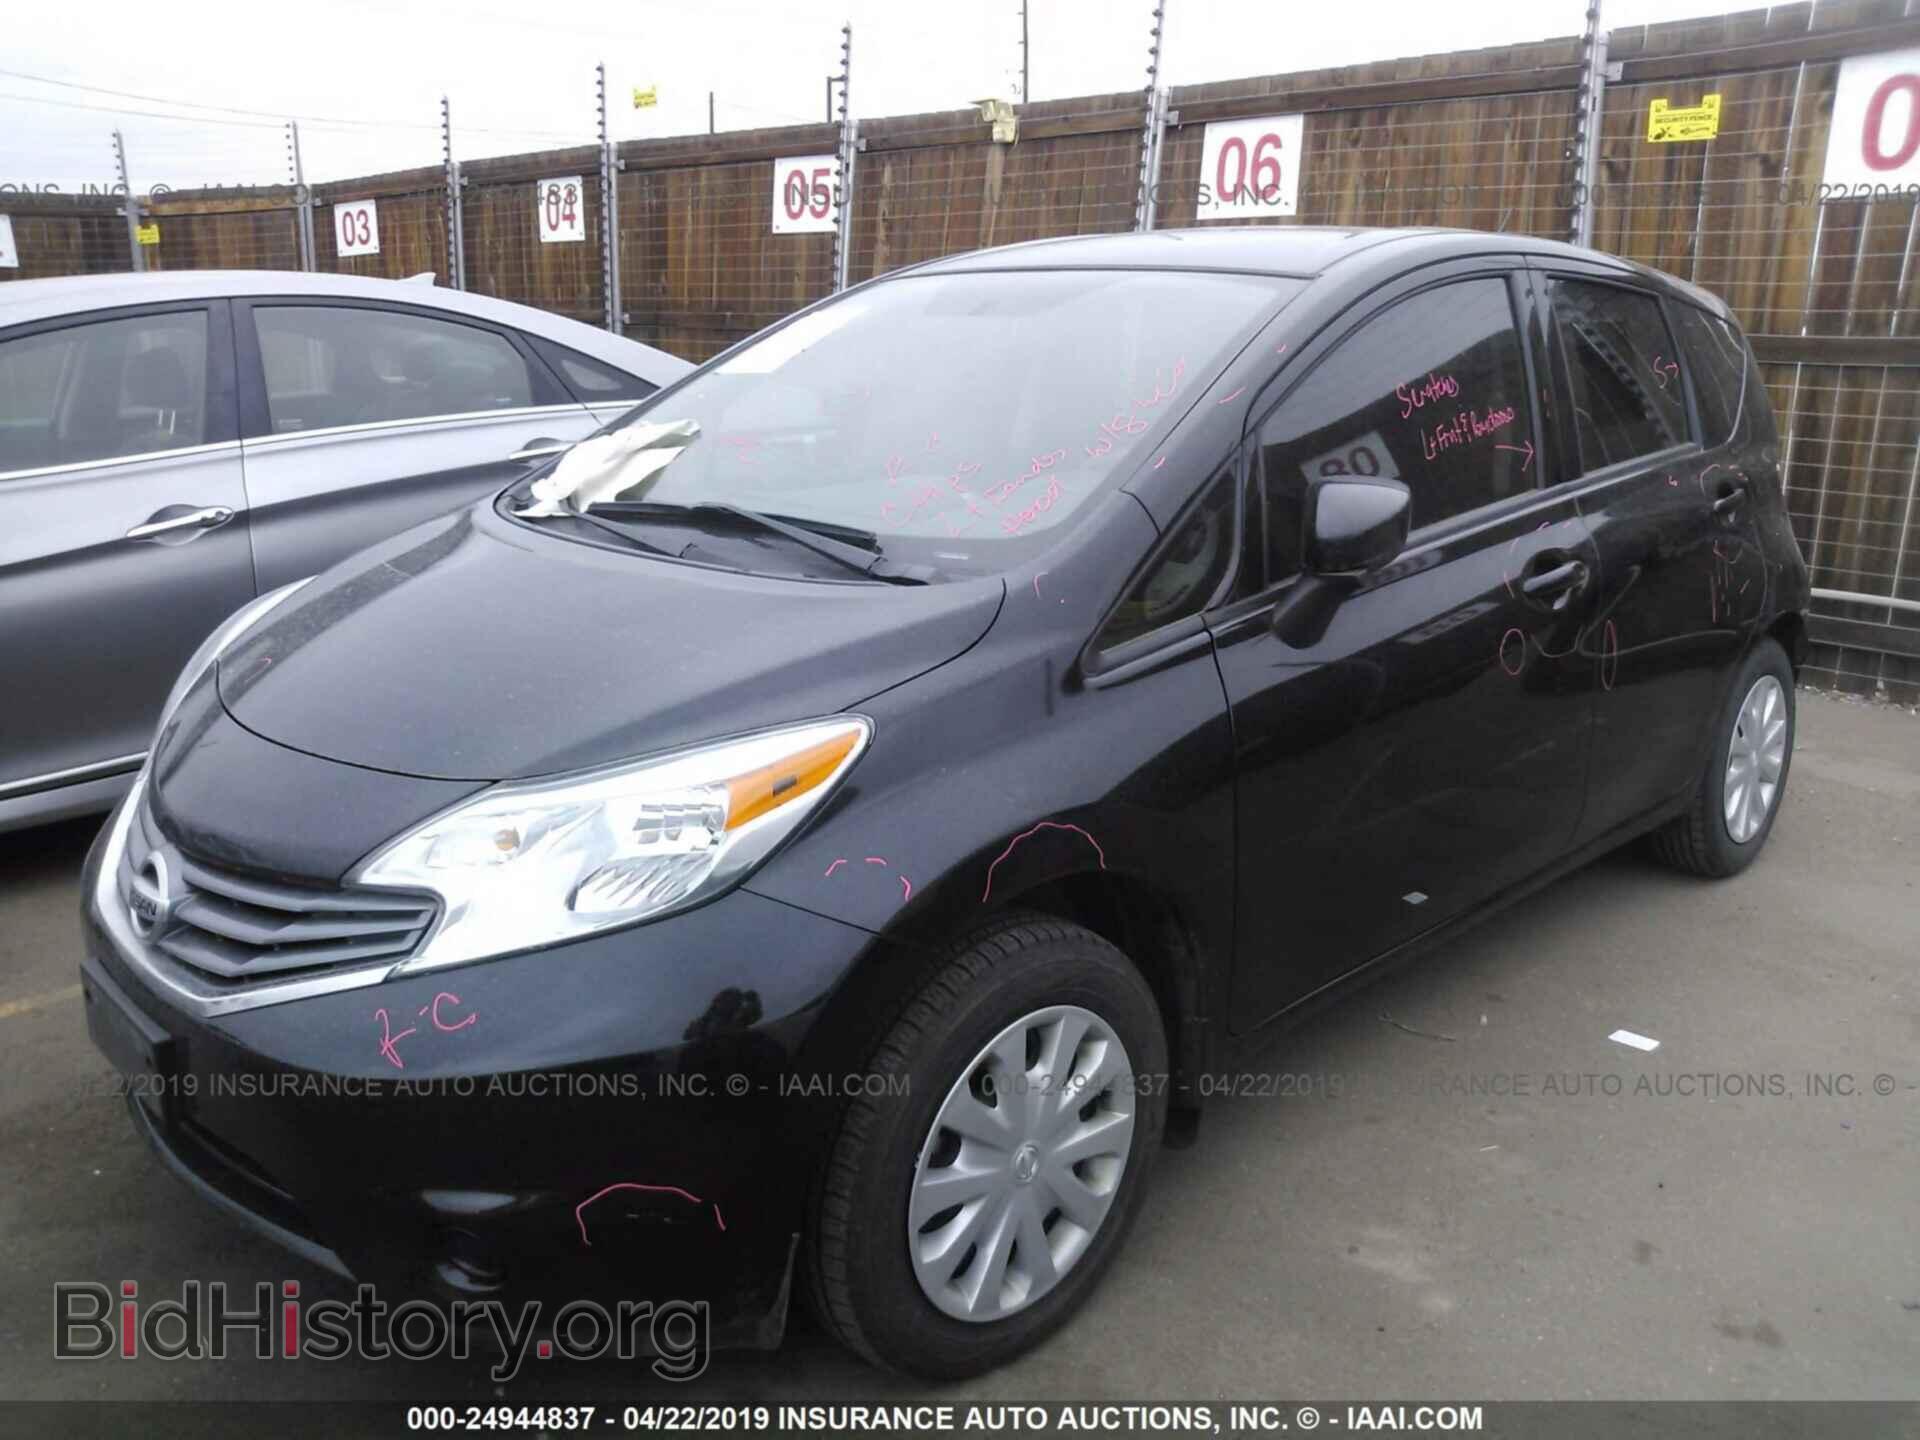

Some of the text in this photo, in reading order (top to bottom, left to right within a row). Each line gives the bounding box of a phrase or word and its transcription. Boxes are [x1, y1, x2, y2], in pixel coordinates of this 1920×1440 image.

[1216, 133, 1283, 202] 06
[546, 187, 577, 231] 04
[785, 168, 831, 220] 05
[342, 209, 371, 247] 03
